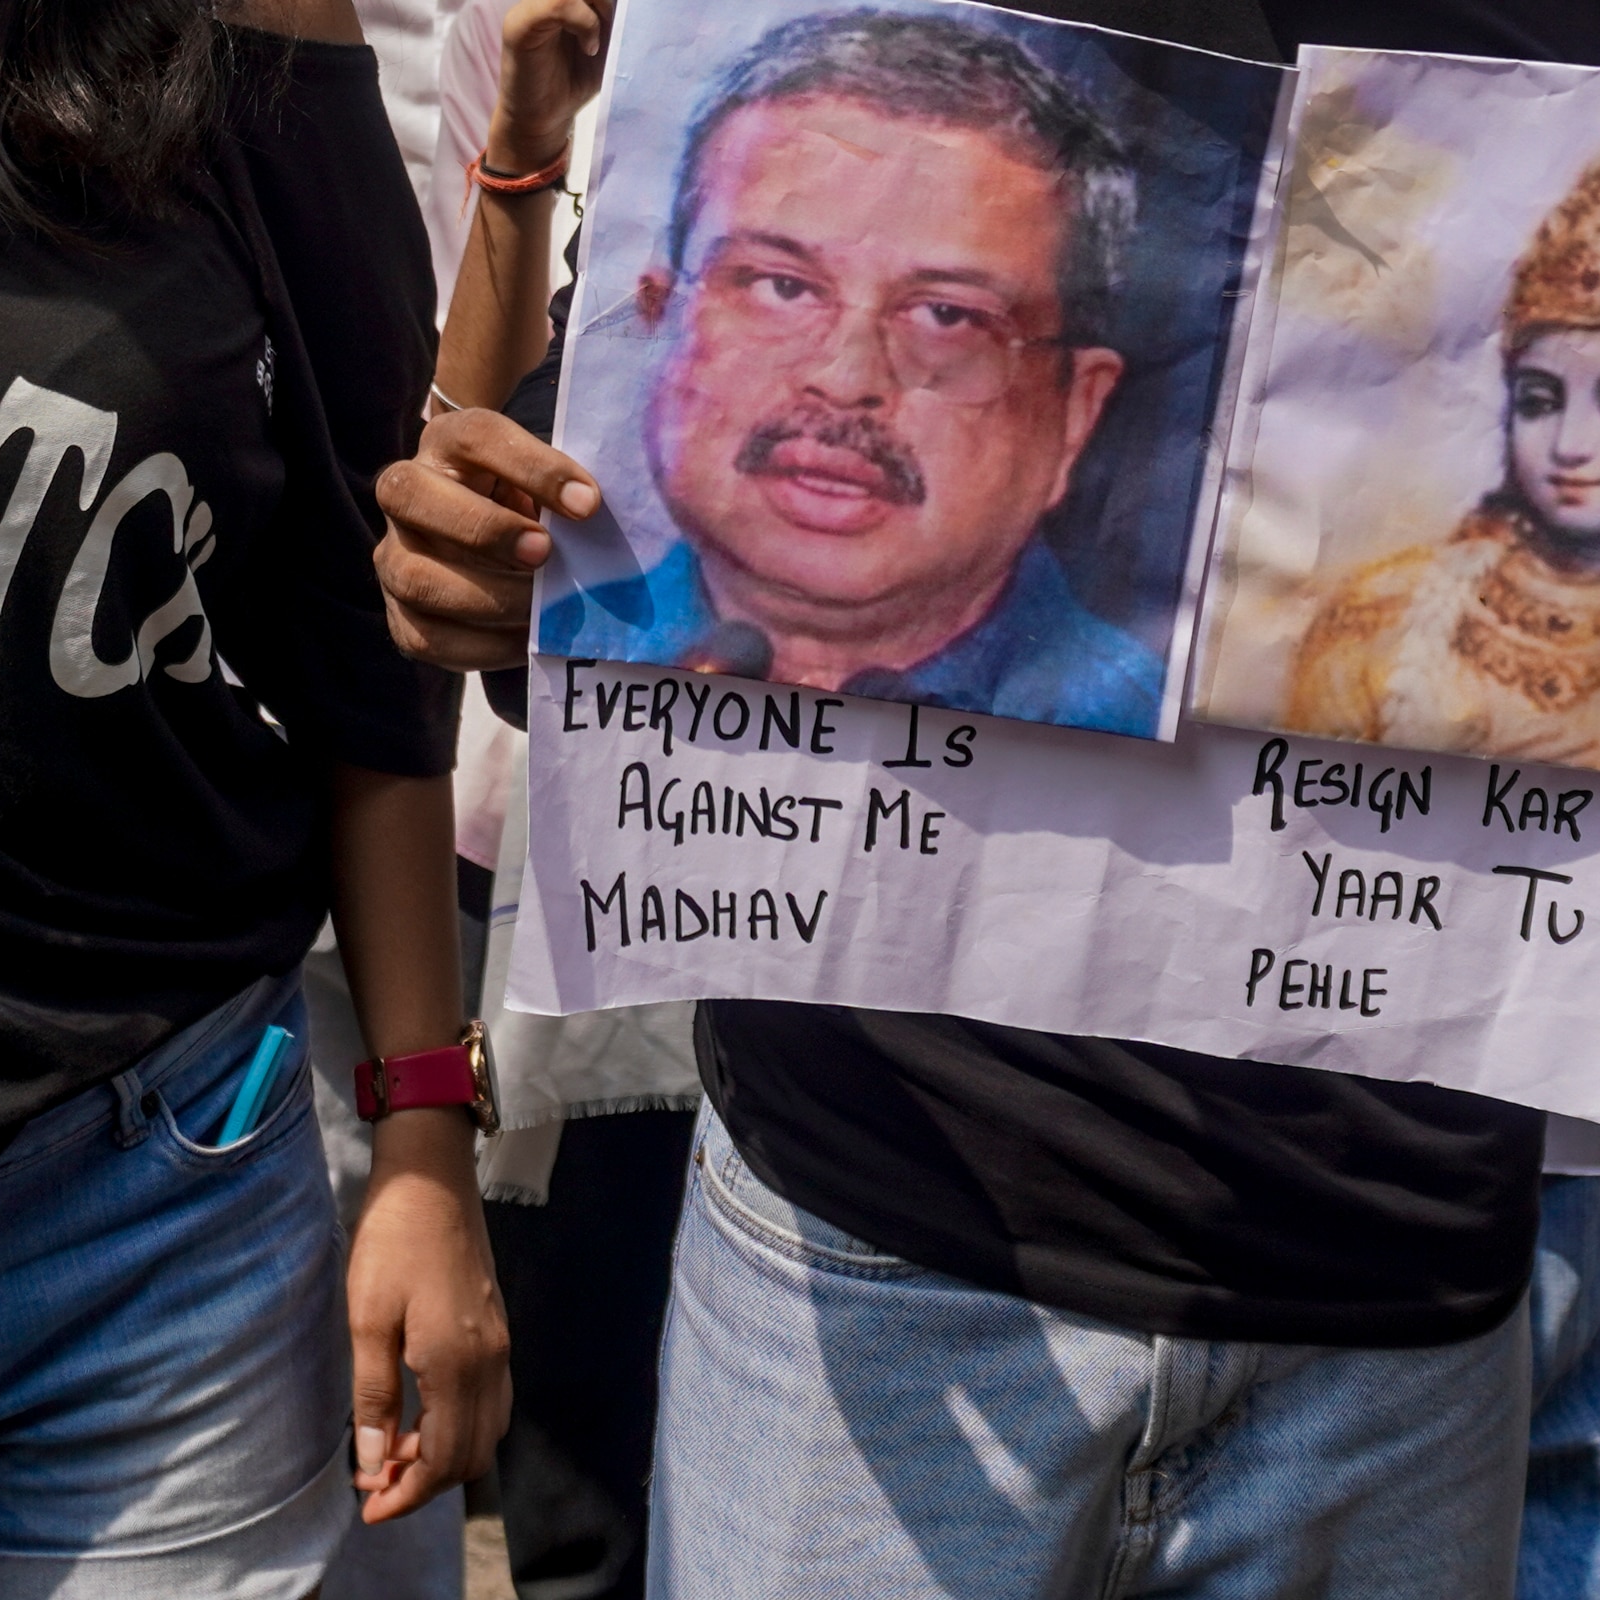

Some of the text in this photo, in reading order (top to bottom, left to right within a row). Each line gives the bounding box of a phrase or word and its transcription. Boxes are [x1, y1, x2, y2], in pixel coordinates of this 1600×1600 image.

[562, 658, 845, 757] EVERYONE
[617, 761, 947, 855] AGAINST ME
[1251, 737, 1594, 843] RESIGN KAR
[579, 871, 829, 953] MADHAV
[1301, 849, 1443, 932] YAAR
[1245, 947, 1389, 1018] PEHLE
